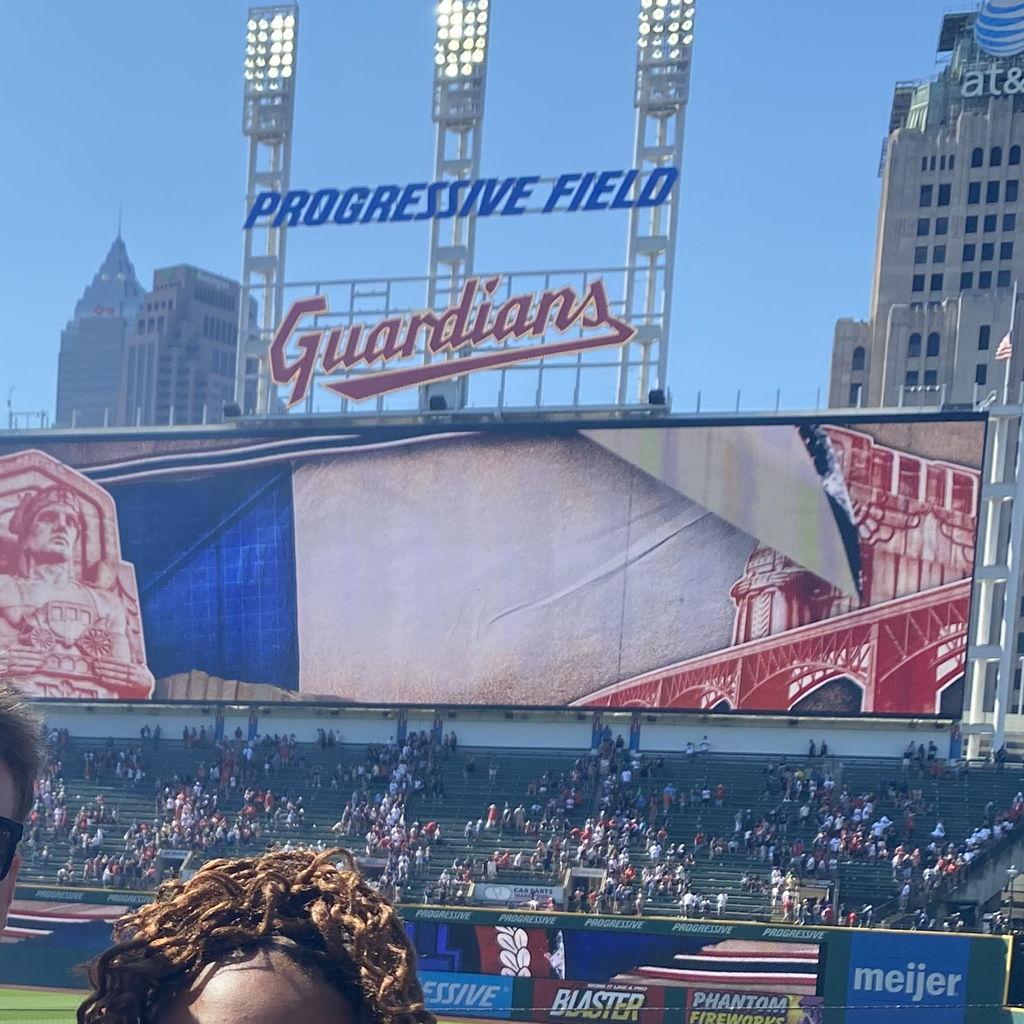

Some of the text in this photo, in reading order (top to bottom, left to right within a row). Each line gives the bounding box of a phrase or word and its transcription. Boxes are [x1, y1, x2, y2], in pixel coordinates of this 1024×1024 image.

[243, 167, 679, 229] PROGRESSIVE FIELD
[268, 273, 638, 408] Guardians
[415, 909, 472, 921] PROGRESSIVE
[498, 913, 558, 925] PROGRESSIVE
[584, 917, 645, 929] PROGRESSIVE
[672, 922, 734, 935] PROGRESSIVE
[762, 927, 826, 940] PROGRESSIVE
[854, 962, 962, 1001] meijer
[423, 980, 501, 1007] ESSIVE
[549, 988, 646, 1021] BLASTER
[693, 991, 788, 1014] PHANTOM
